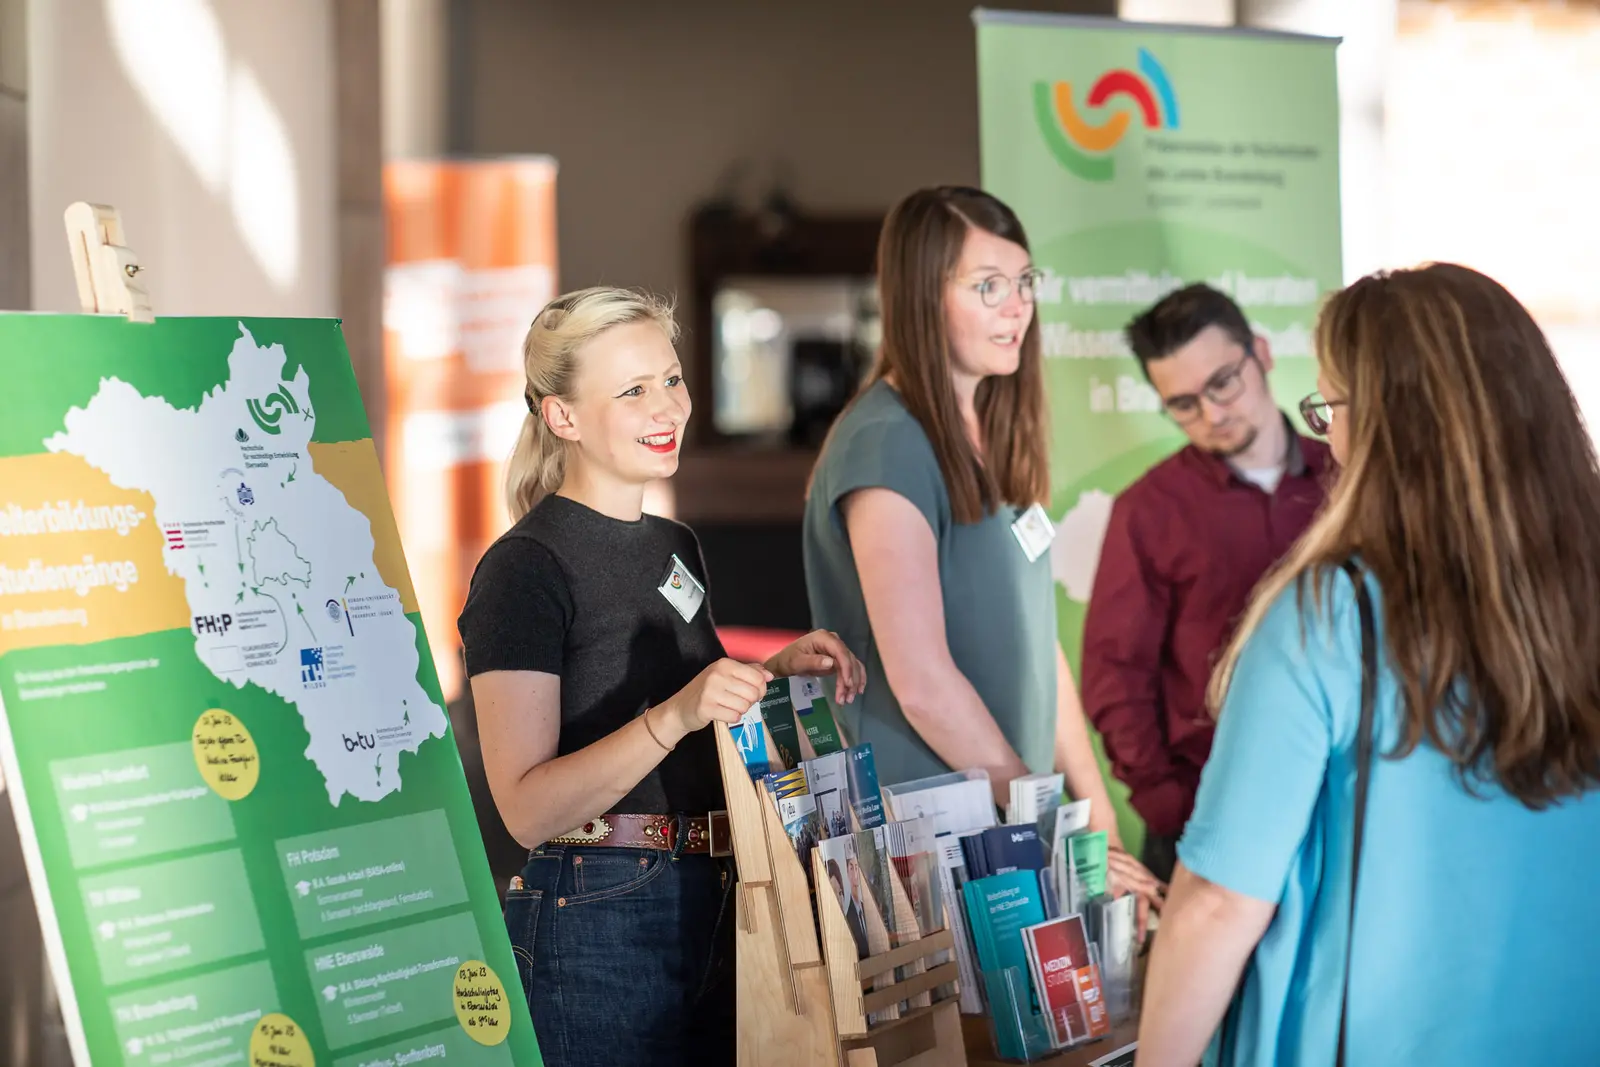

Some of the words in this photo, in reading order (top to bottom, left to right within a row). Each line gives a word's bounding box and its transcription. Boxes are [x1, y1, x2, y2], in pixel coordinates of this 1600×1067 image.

[0, 498, 147, 537] eiterbildungs-
[301, 845, 340, 864] Potsdam
[335, 944, 385, 967] Eberswalde
[479, 967, 487, 977] 23
